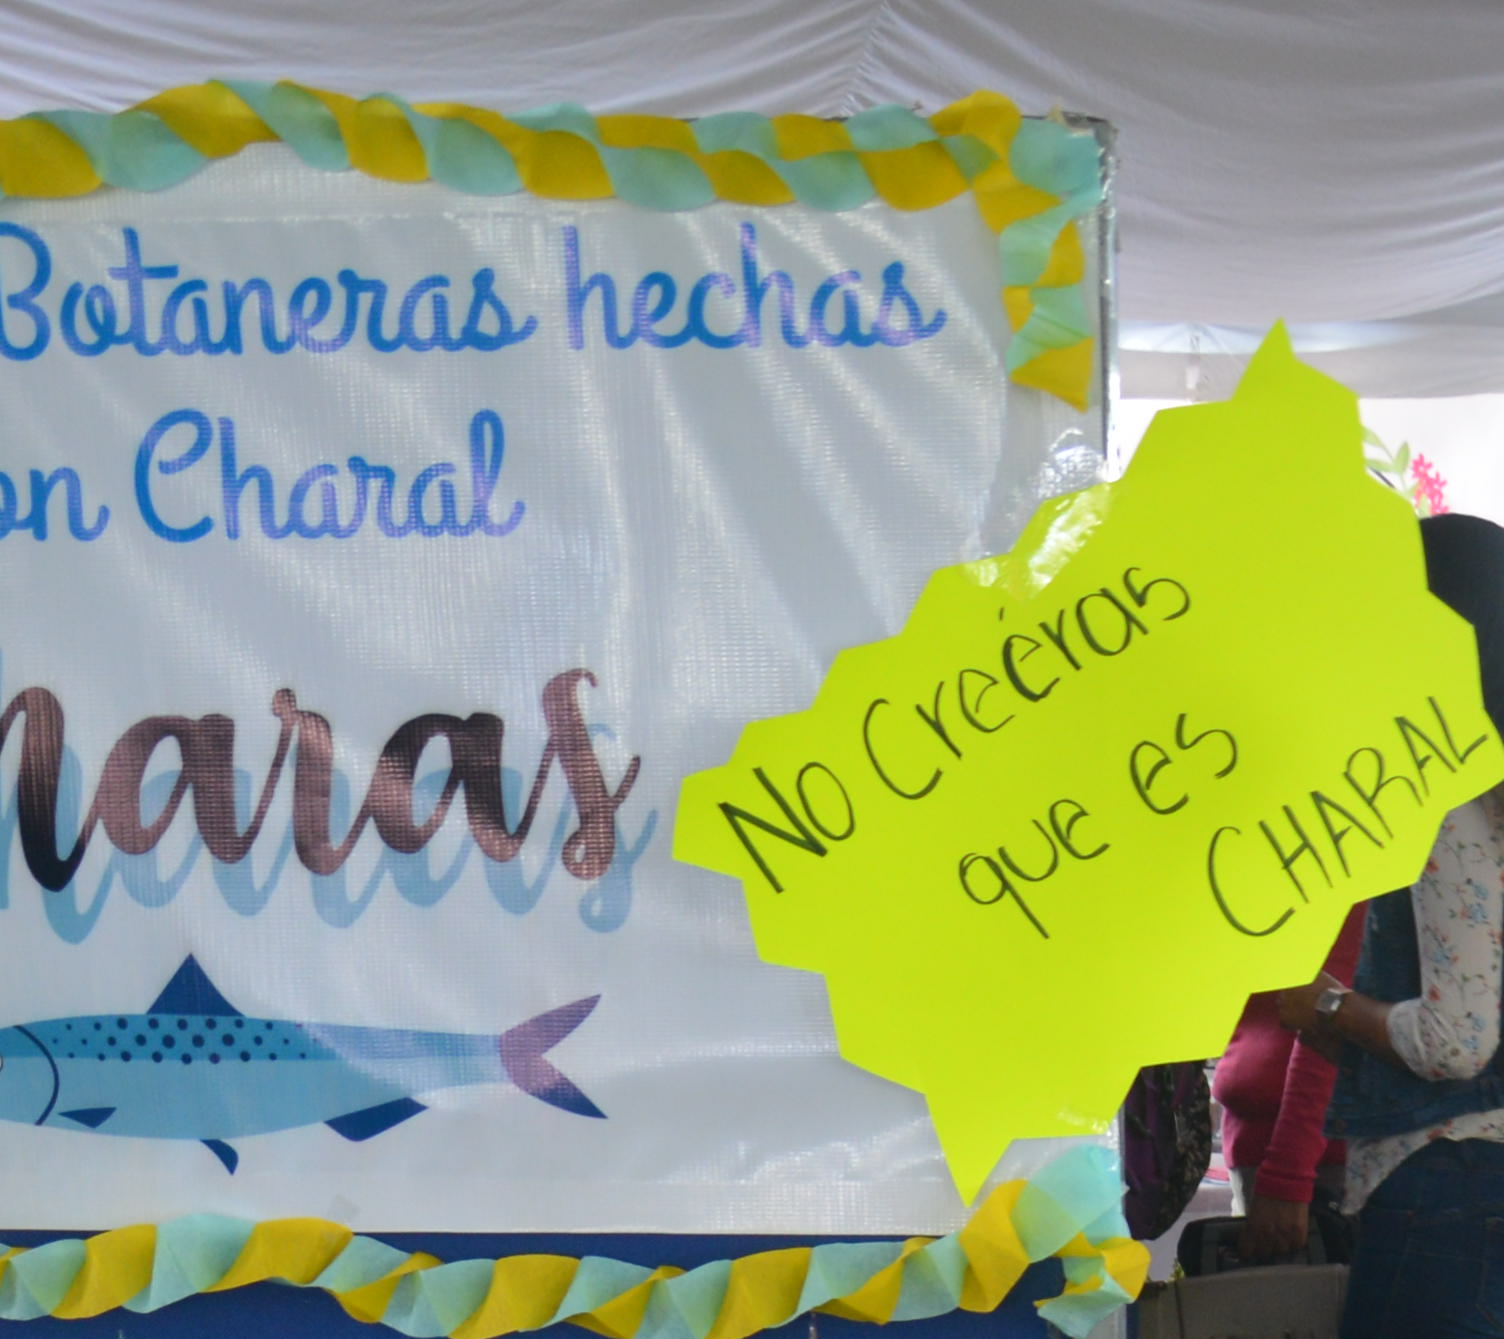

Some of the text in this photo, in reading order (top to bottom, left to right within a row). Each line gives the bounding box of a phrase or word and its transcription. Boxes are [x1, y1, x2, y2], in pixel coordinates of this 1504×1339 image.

[564, 226, 948, 357] hechas
[134, 408, 526, 543] Charal
[957, 712, 1238, 939] que es
[1205, 694, 1488, 937] CHARAL
